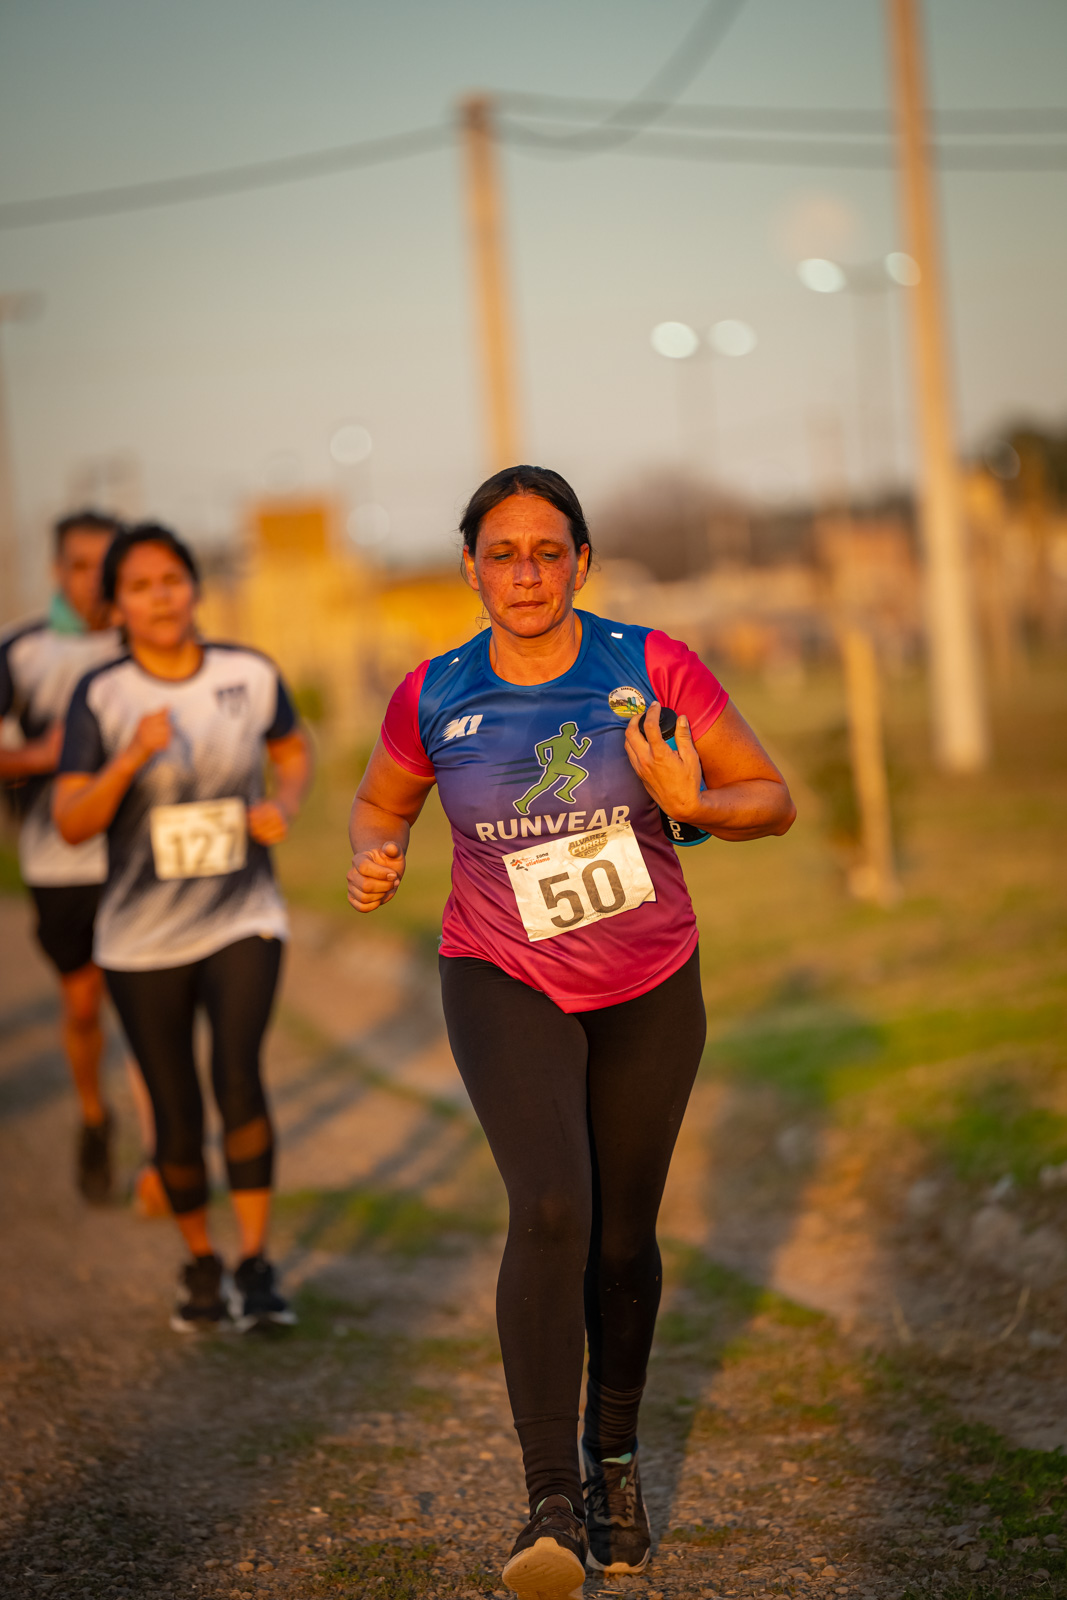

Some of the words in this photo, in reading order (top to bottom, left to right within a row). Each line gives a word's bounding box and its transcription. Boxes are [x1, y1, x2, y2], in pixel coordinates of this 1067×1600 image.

[475, 805, 630, 842] RUNVEAR
[569, 831, 608, 850] ALVAREZ
[571, 837, 609, 856] CORRE
[538, 859, 626, 928] 50
